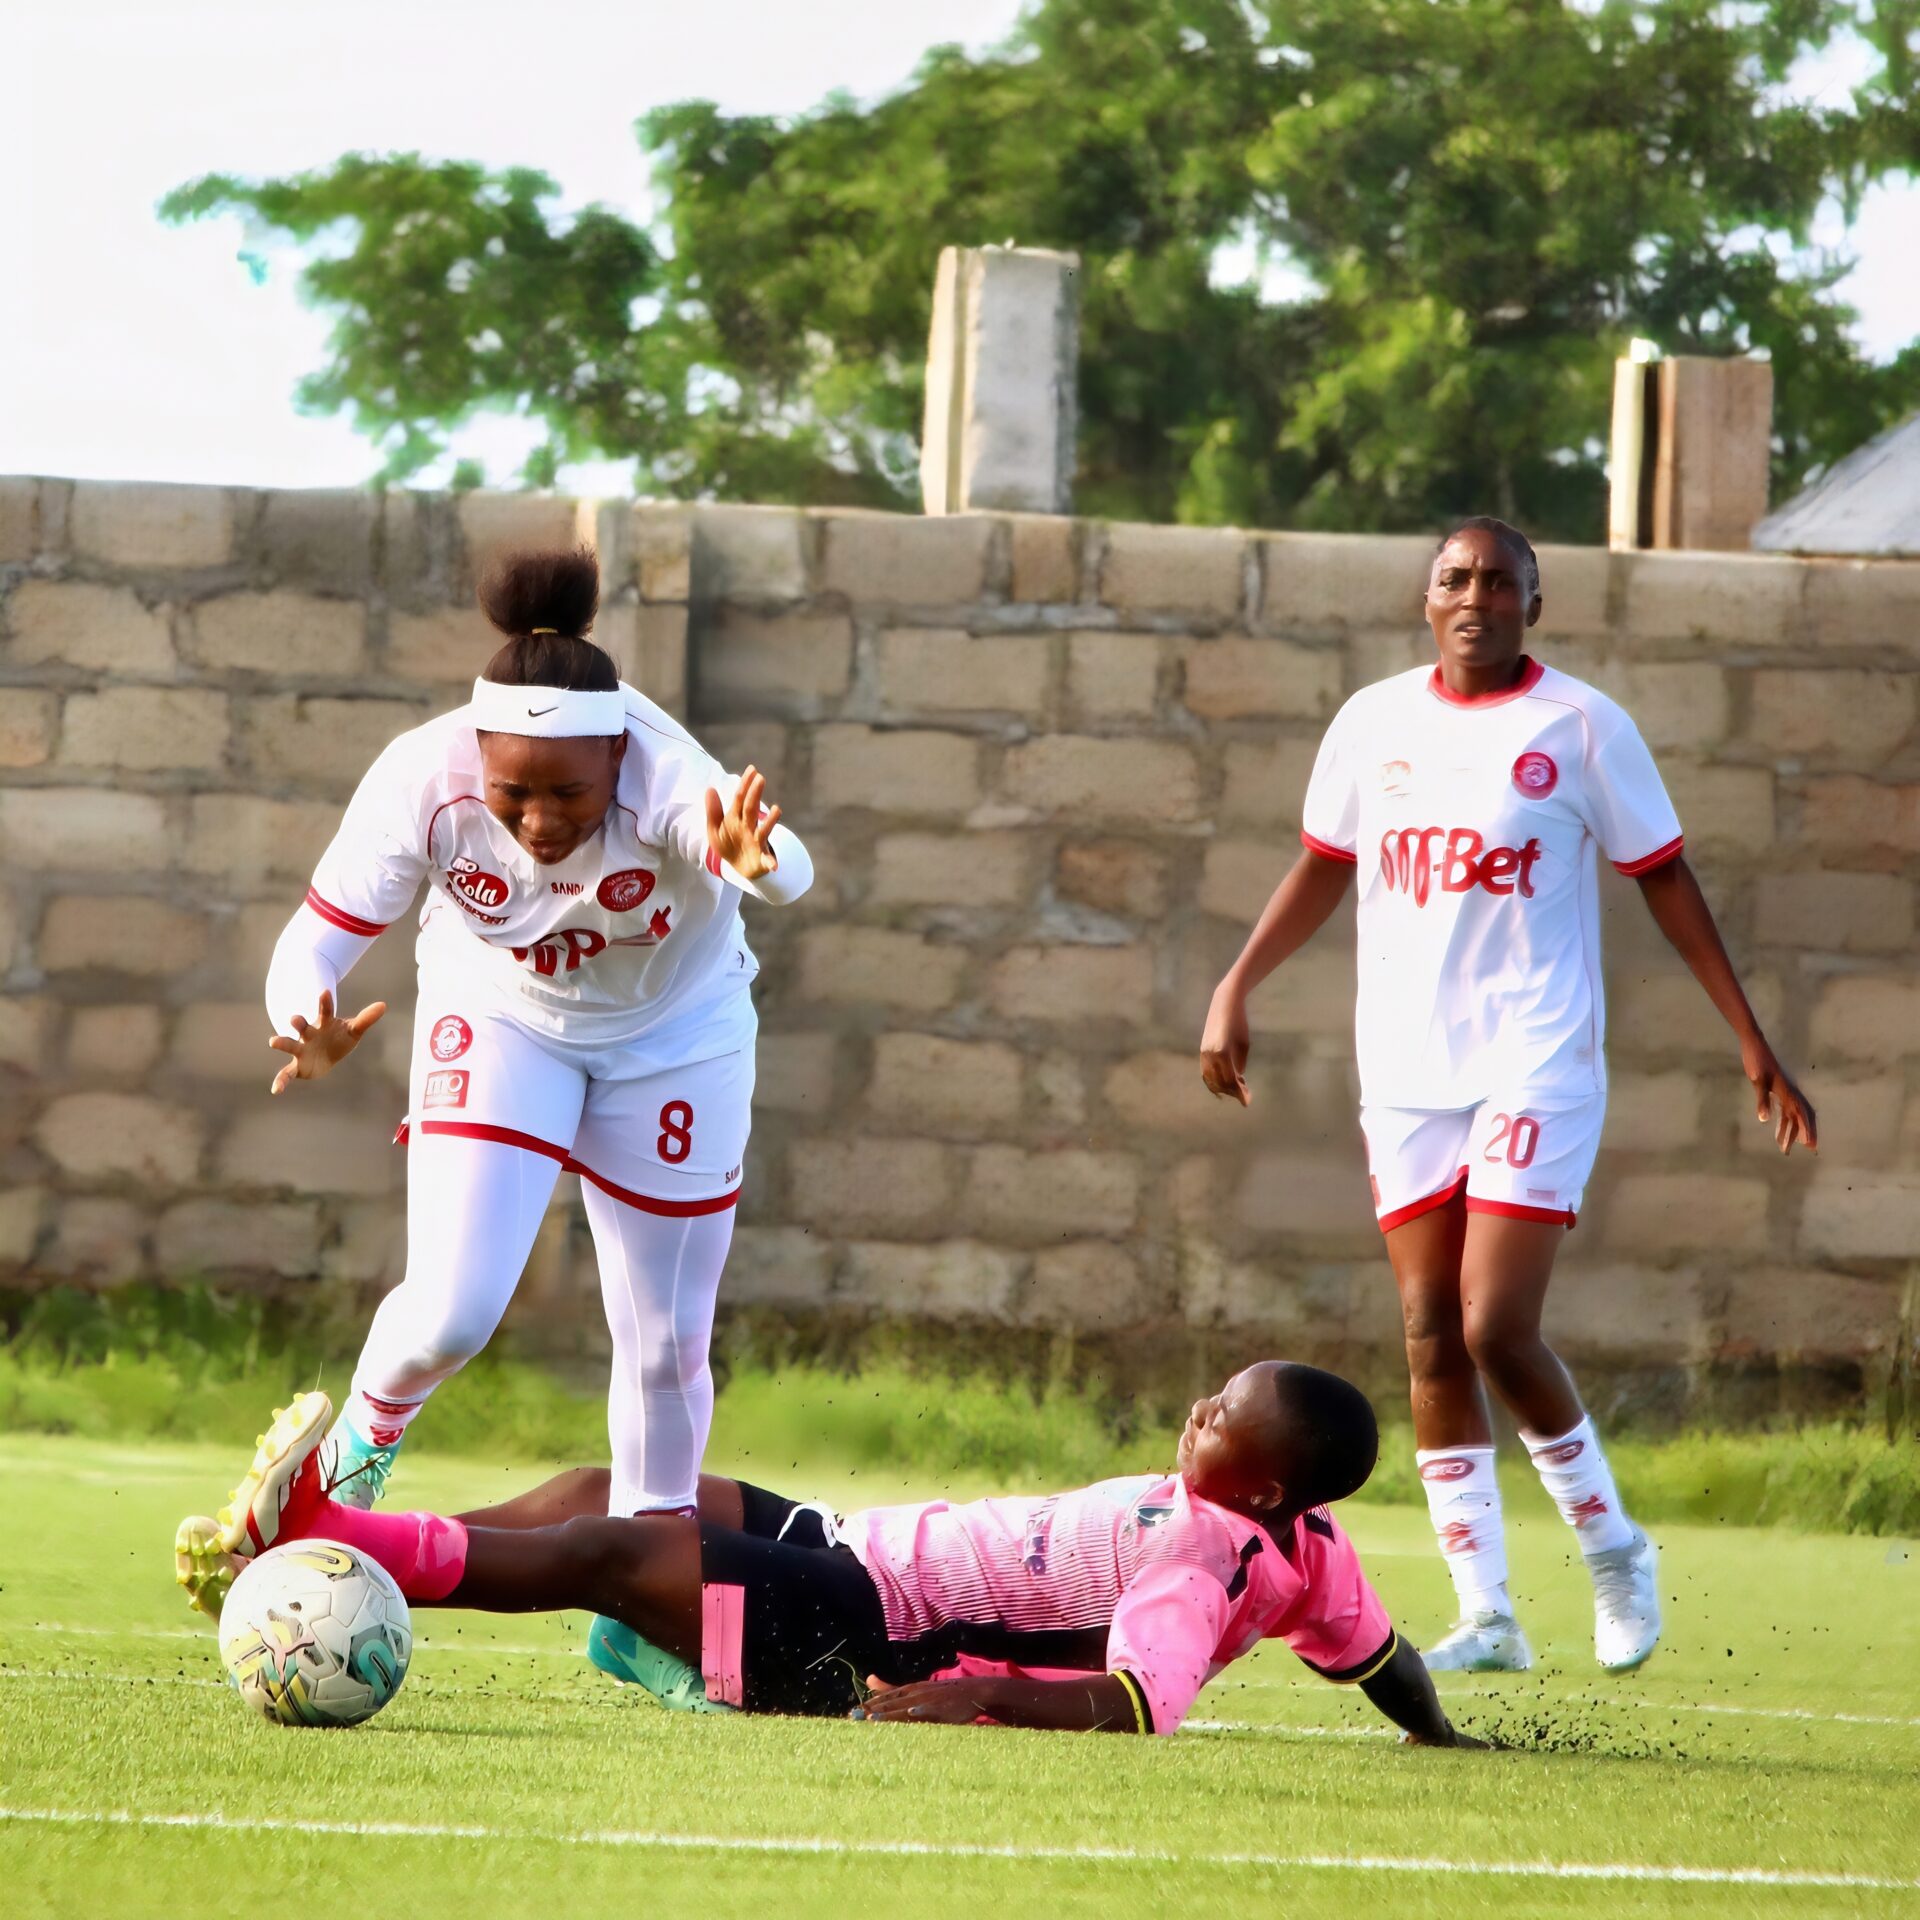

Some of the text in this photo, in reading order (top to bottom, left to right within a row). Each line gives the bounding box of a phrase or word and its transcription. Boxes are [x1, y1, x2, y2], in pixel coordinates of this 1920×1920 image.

[453, 874, 498, 905] Cola
[657, 1100, 694, 1164] 8
[1484, 1113, 1540, 1169] 20
